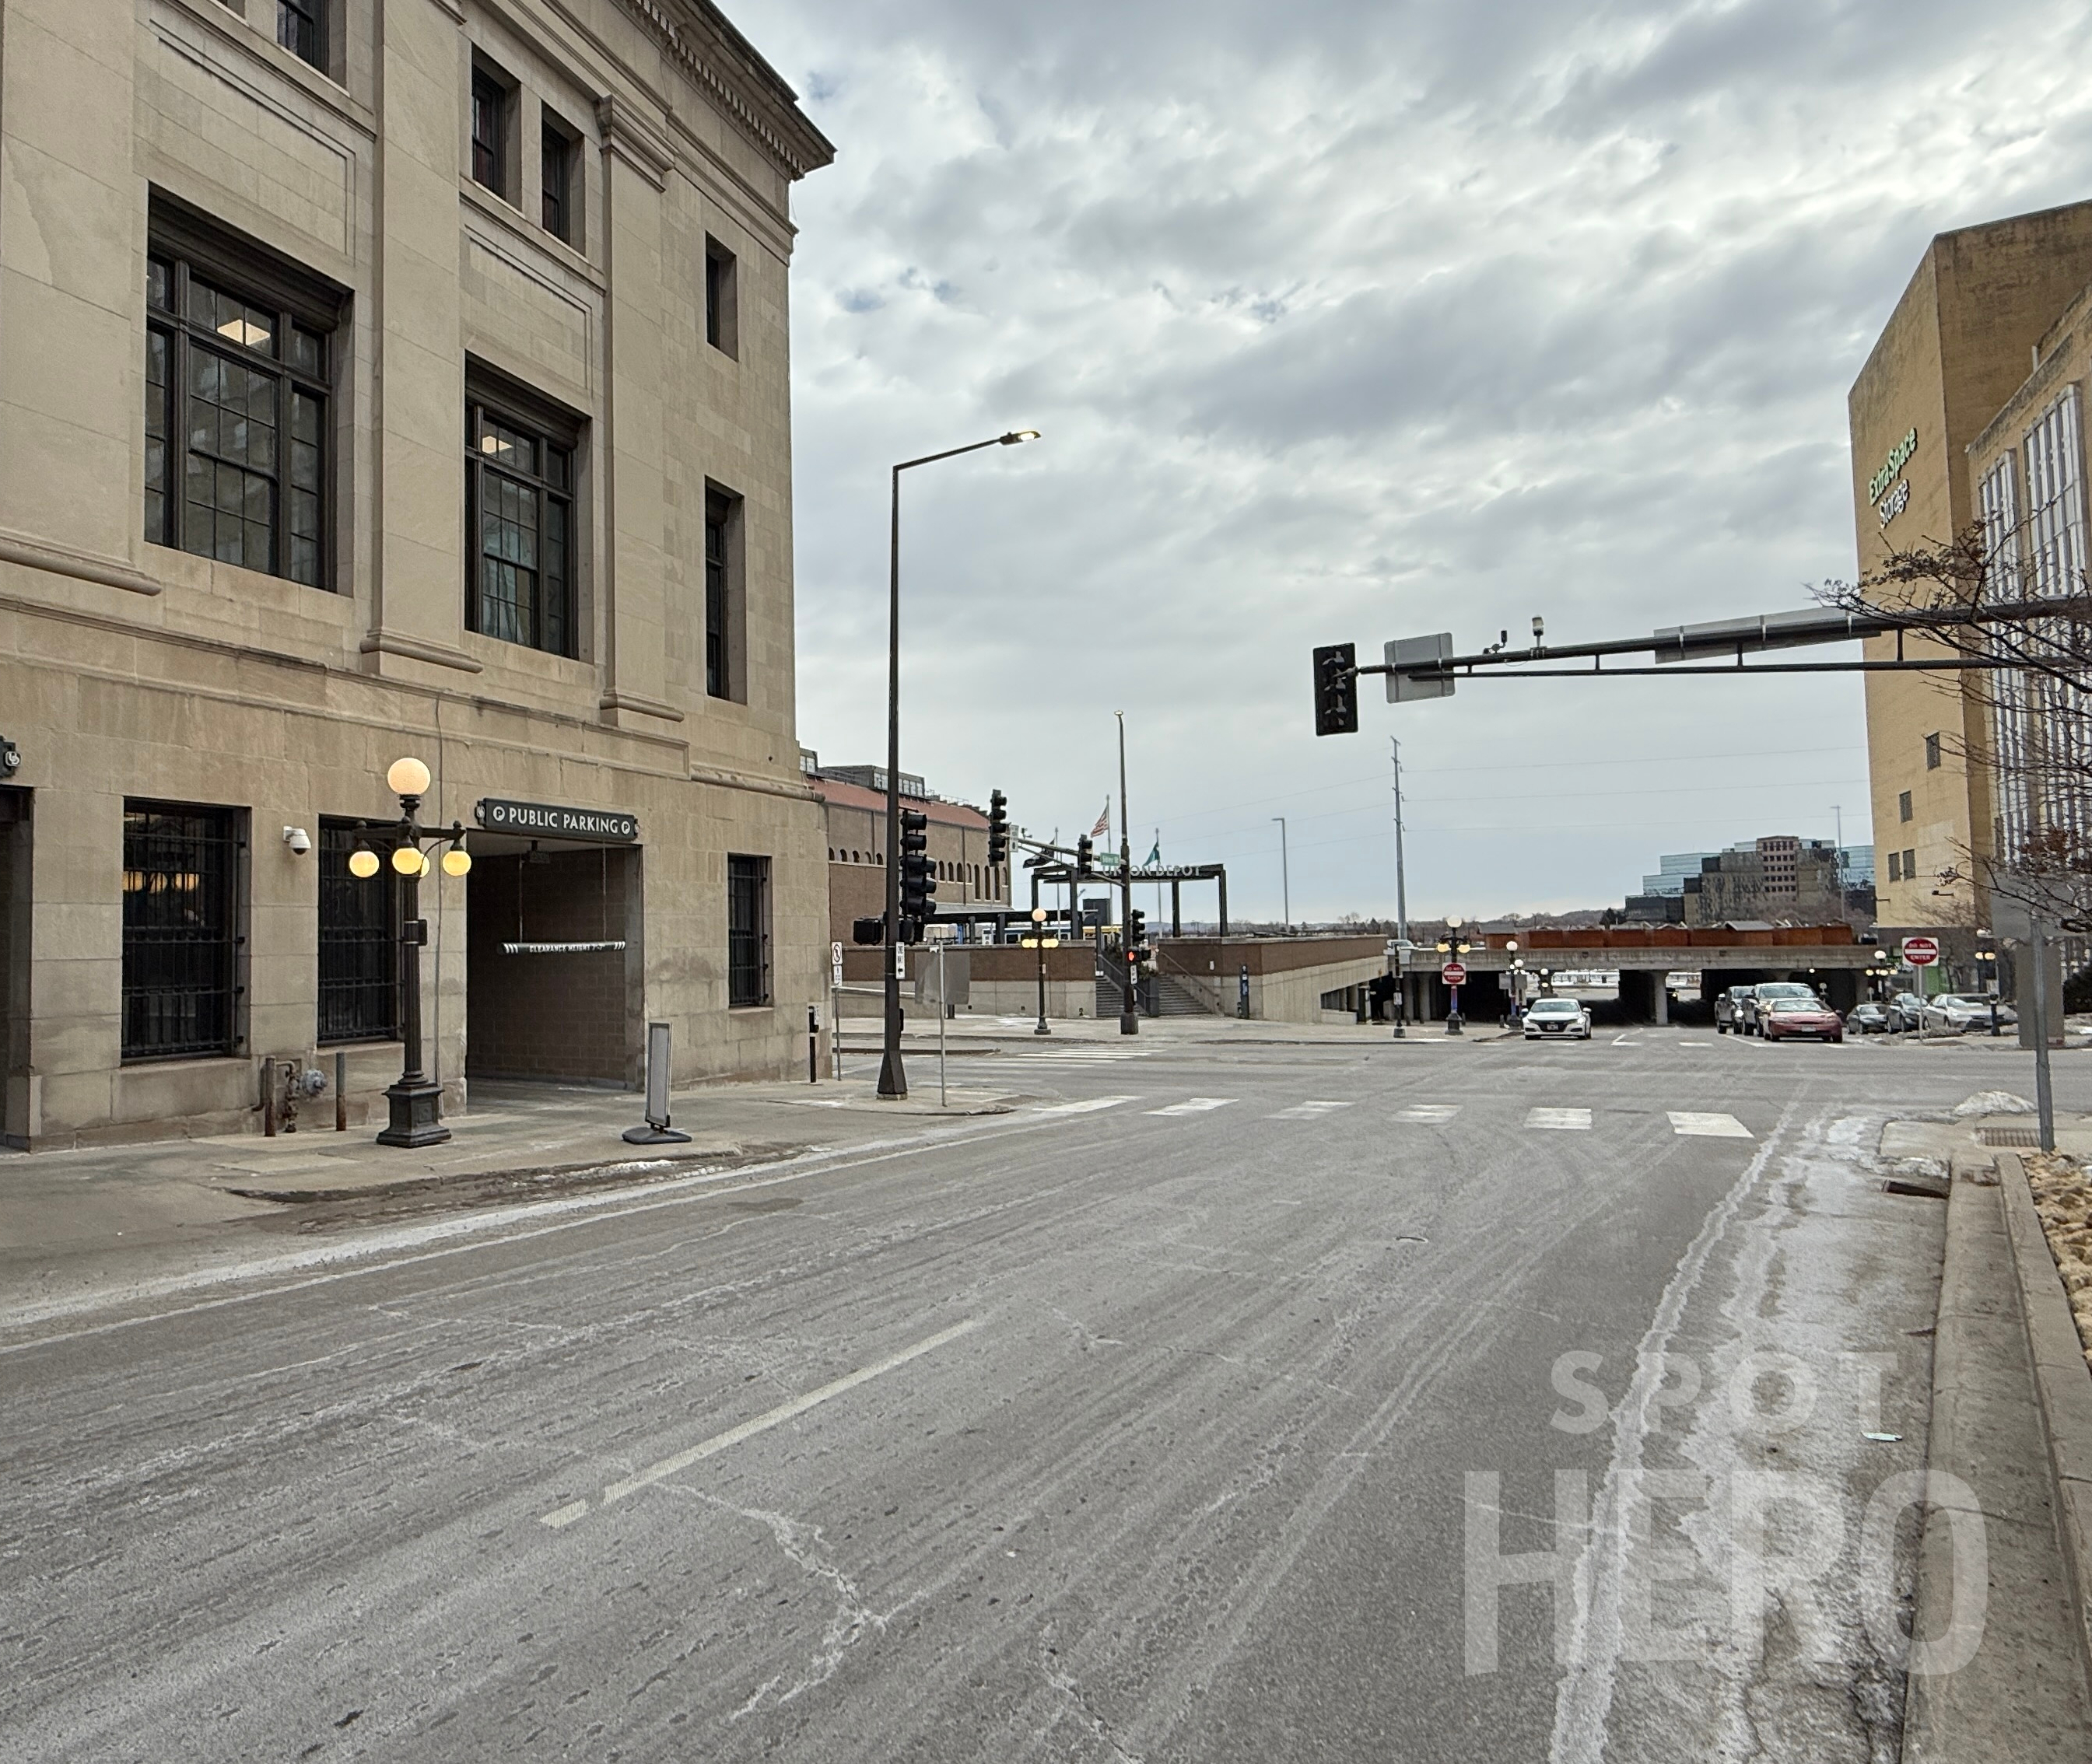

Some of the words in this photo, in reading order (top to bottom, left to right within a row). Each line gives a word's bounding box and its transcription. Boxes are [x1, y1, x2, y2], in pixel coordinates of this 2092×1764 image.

[1880, 479, 1909, 529] Storage
[509, 807, 558, 828] PUBLIC
[563, 814, 618, 834] PARKING
[1103, 865, 1151, 877] UNON
[1156, 865, 1200, 877] DEPOT
